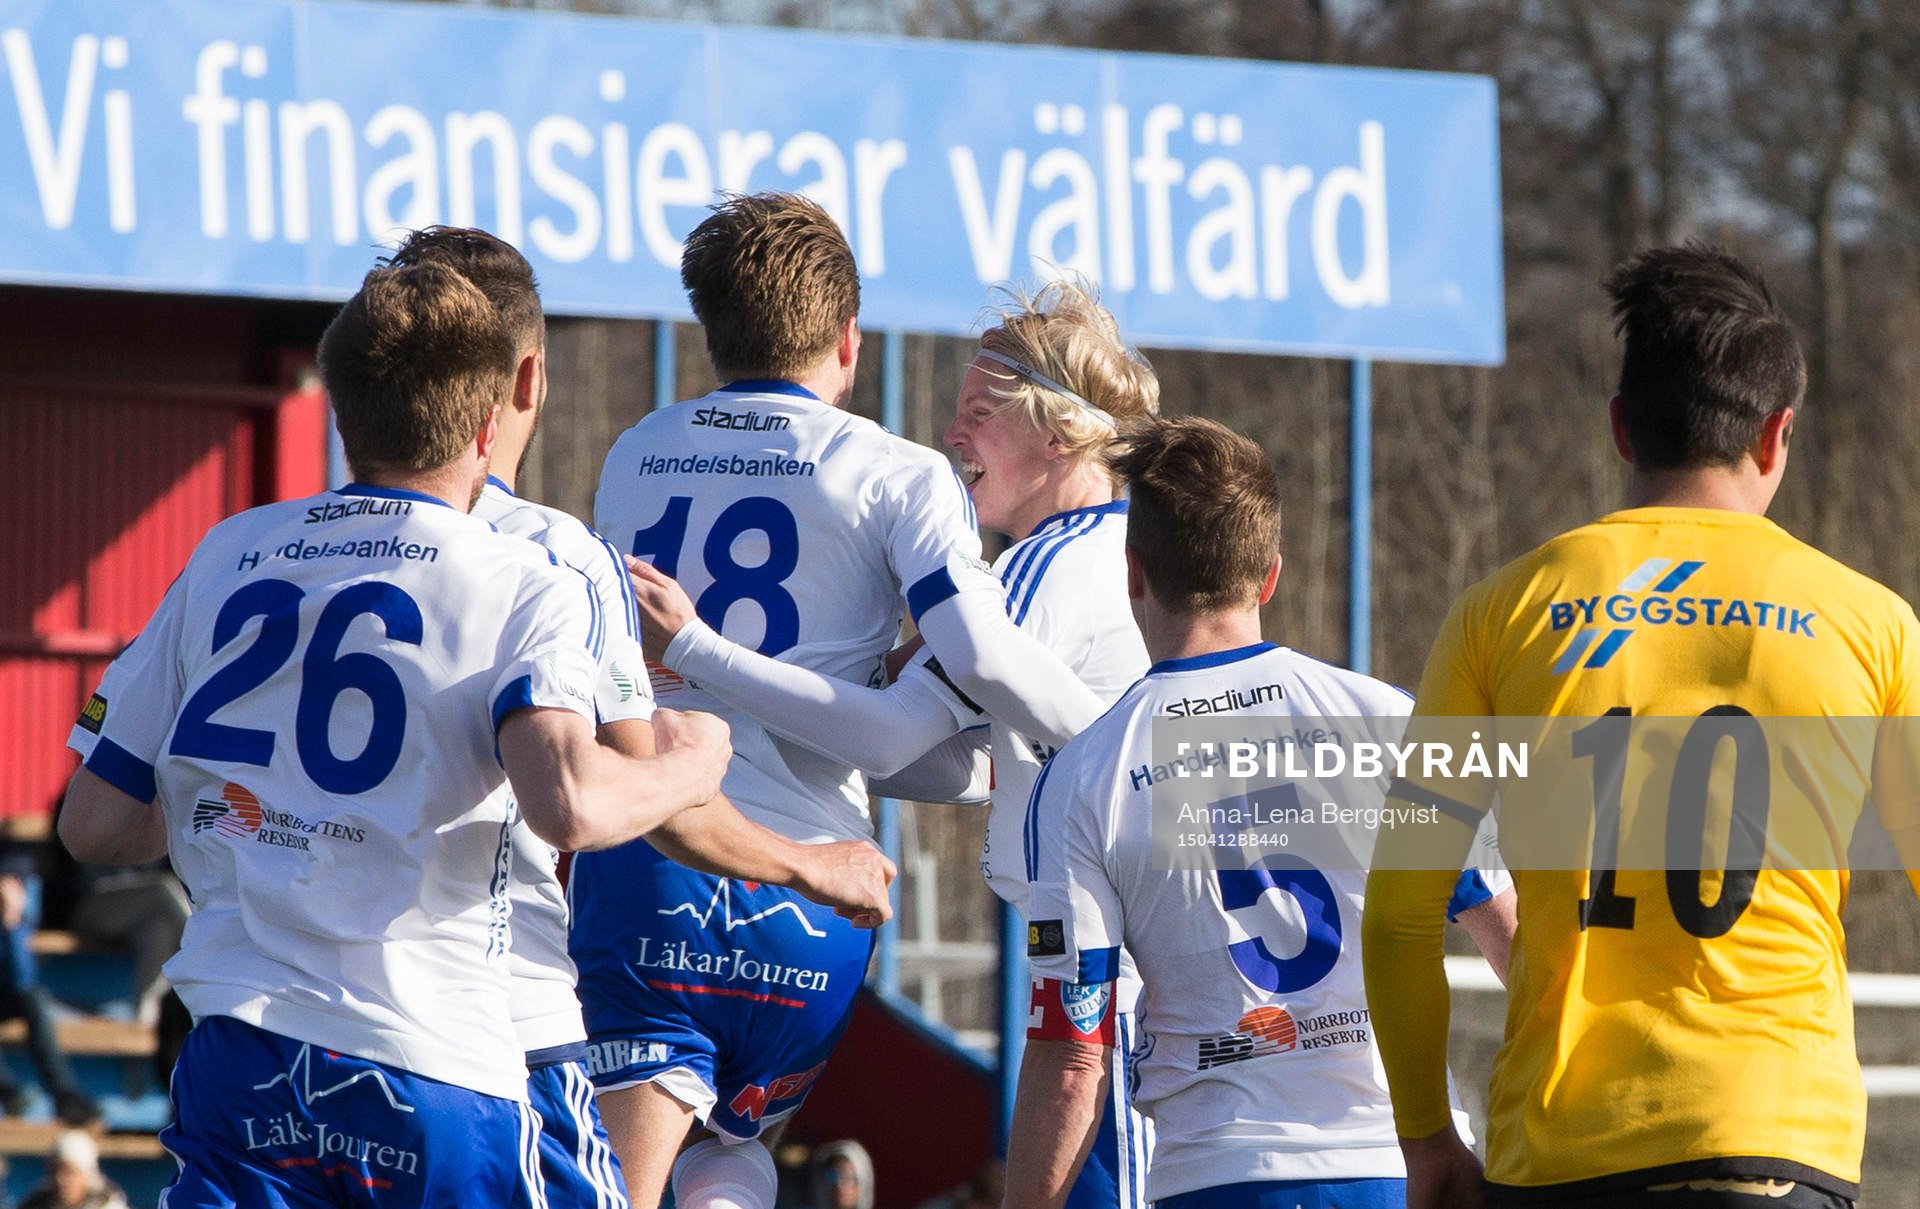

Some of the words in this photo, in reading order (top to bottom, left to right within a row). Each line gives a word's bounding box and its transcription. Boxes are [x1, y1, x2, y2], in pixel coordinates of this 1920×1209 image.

[3, 28, 137, 233] Vi
[949, 102, 1391, 308] välfärd
[691, 406, 790, 432] stadium
[639, 453, 815, 477] Handelsbanken
[304, 497, 413, 524] stadium
[237, 536, 439, 571] Hdelsbanken
[632, 496, 800, 656] 18
[1549, 595, 1818, 639] BYGGSTATIK
[169, 578, 424, 795] 26
[1166, 684, 1284, 721] stadium
[1571, 704, 1771, 939] 10
[1206, 782, 1342, 994] 5
[636, 936, 829, 992] LäkarJouren
[241, 1112, 418, 1175] LäkJouren
